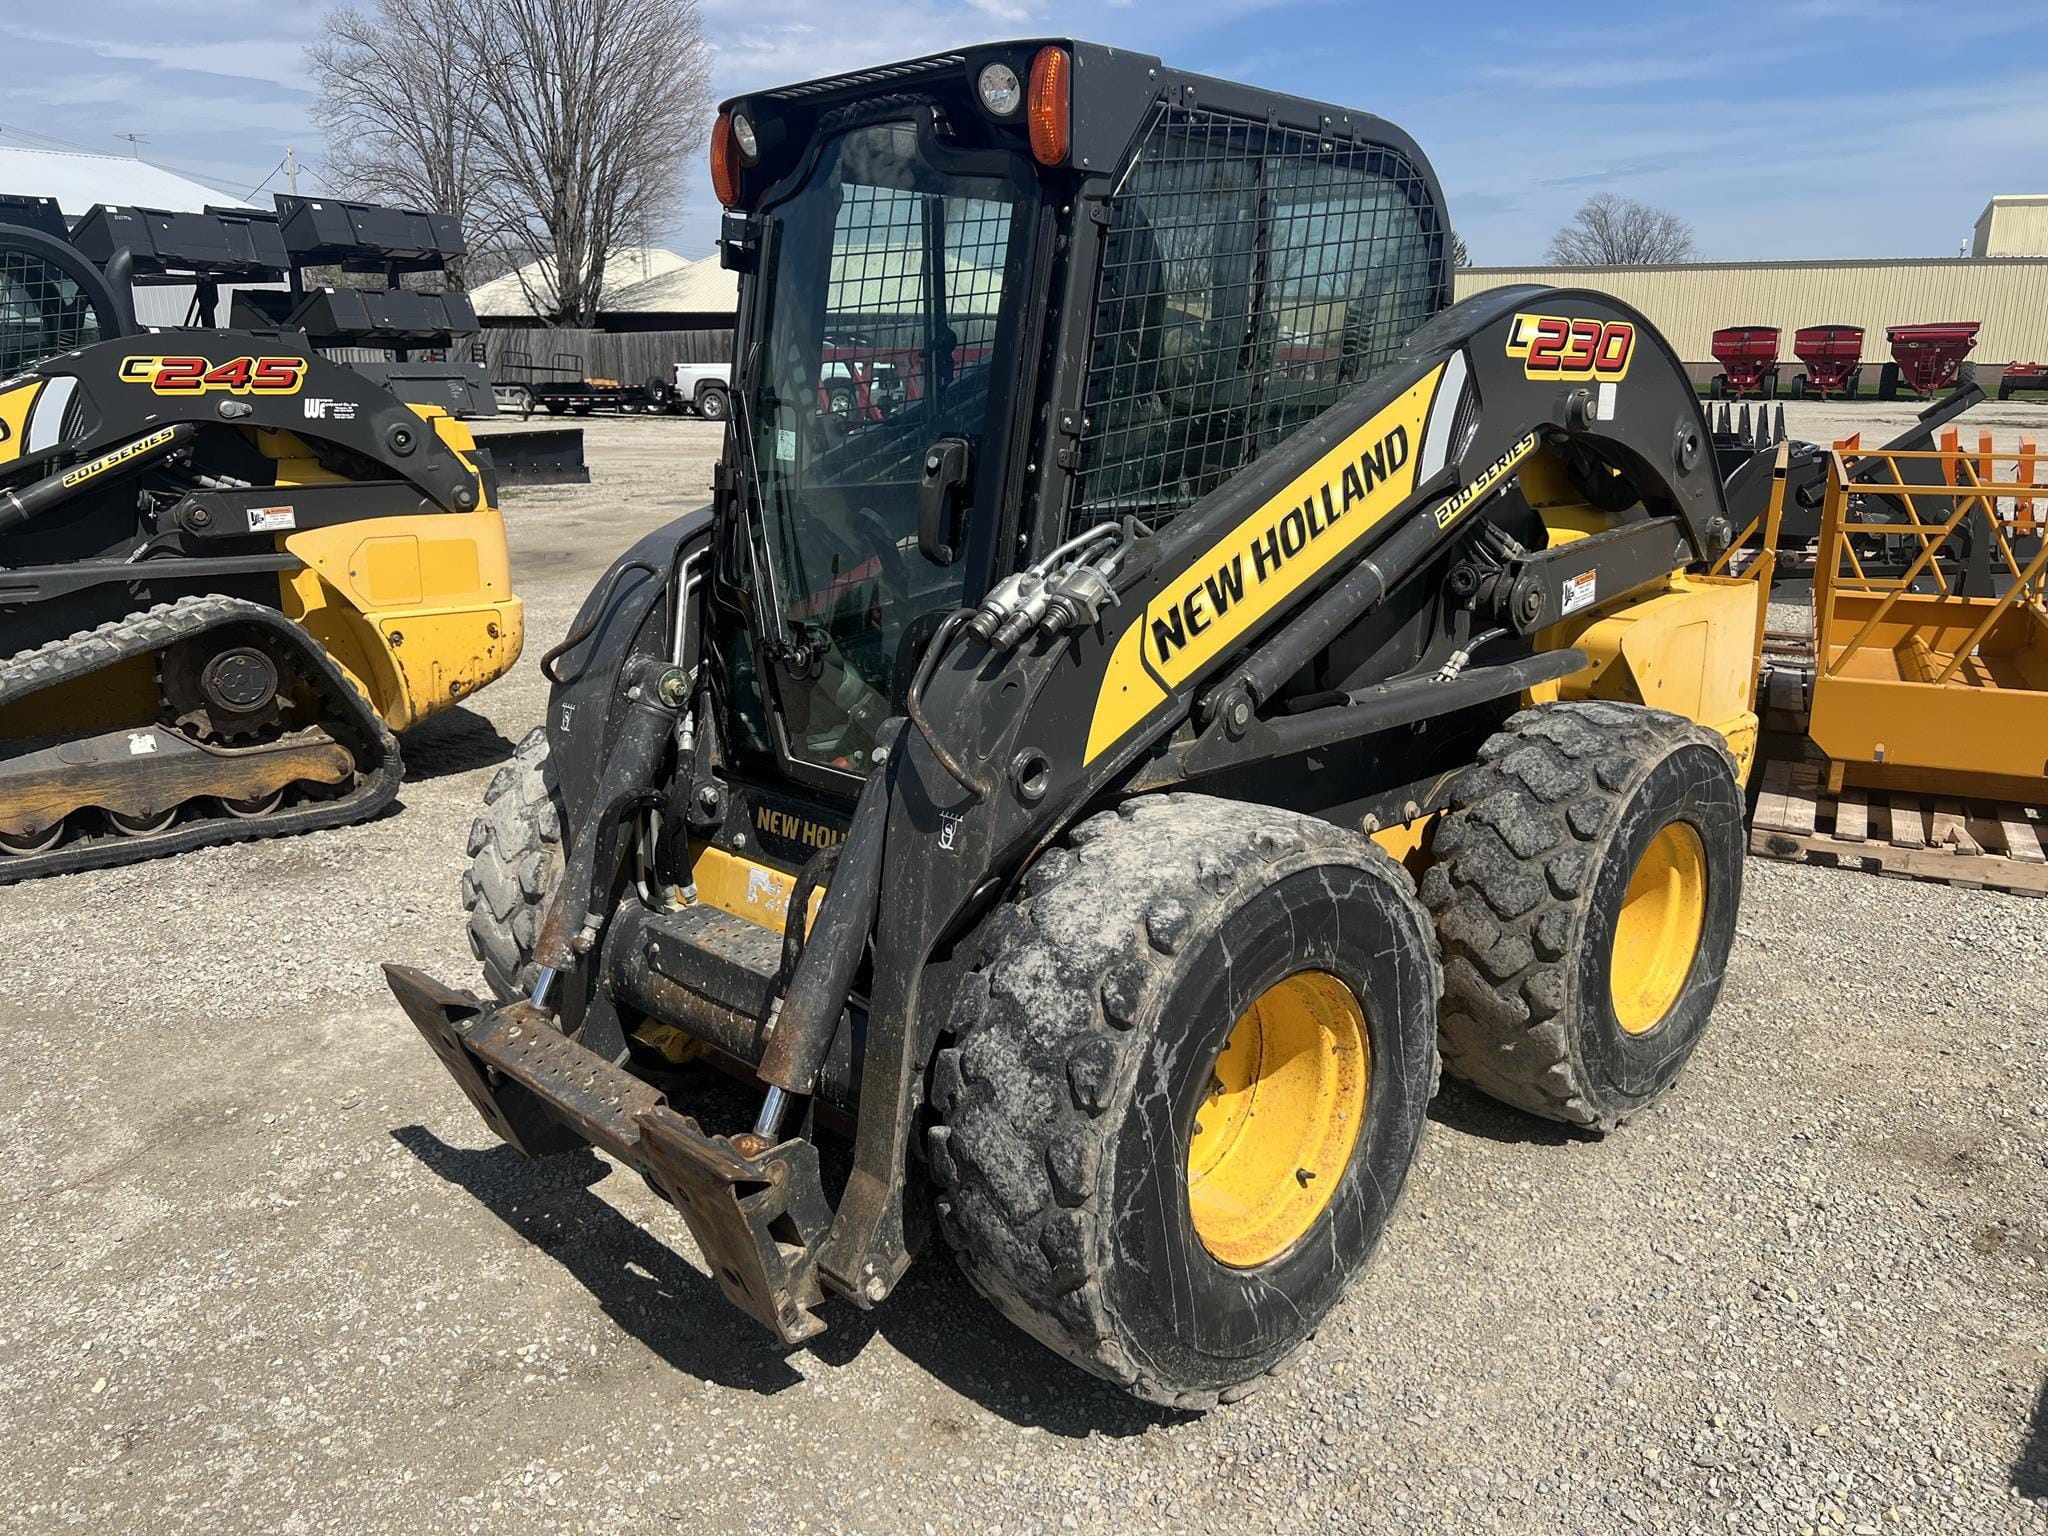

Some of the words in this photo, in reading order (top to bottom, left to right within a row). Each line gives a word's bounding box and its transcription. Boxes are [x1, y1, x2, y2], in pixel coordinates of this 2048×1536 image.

[1507, 316, 1634, 374] L230
[64, 460, 103, 485] 200
[107, 429, 173, 465] SERIES
[1436, 486, 1474, 525] 200
[1475, 434, 1533, 491] SERIES
[1151, 552, 1246, 665] NEW
[1249, 424, 1409, 586] HOLLAND
[756, 806, 801, 841] NEW
